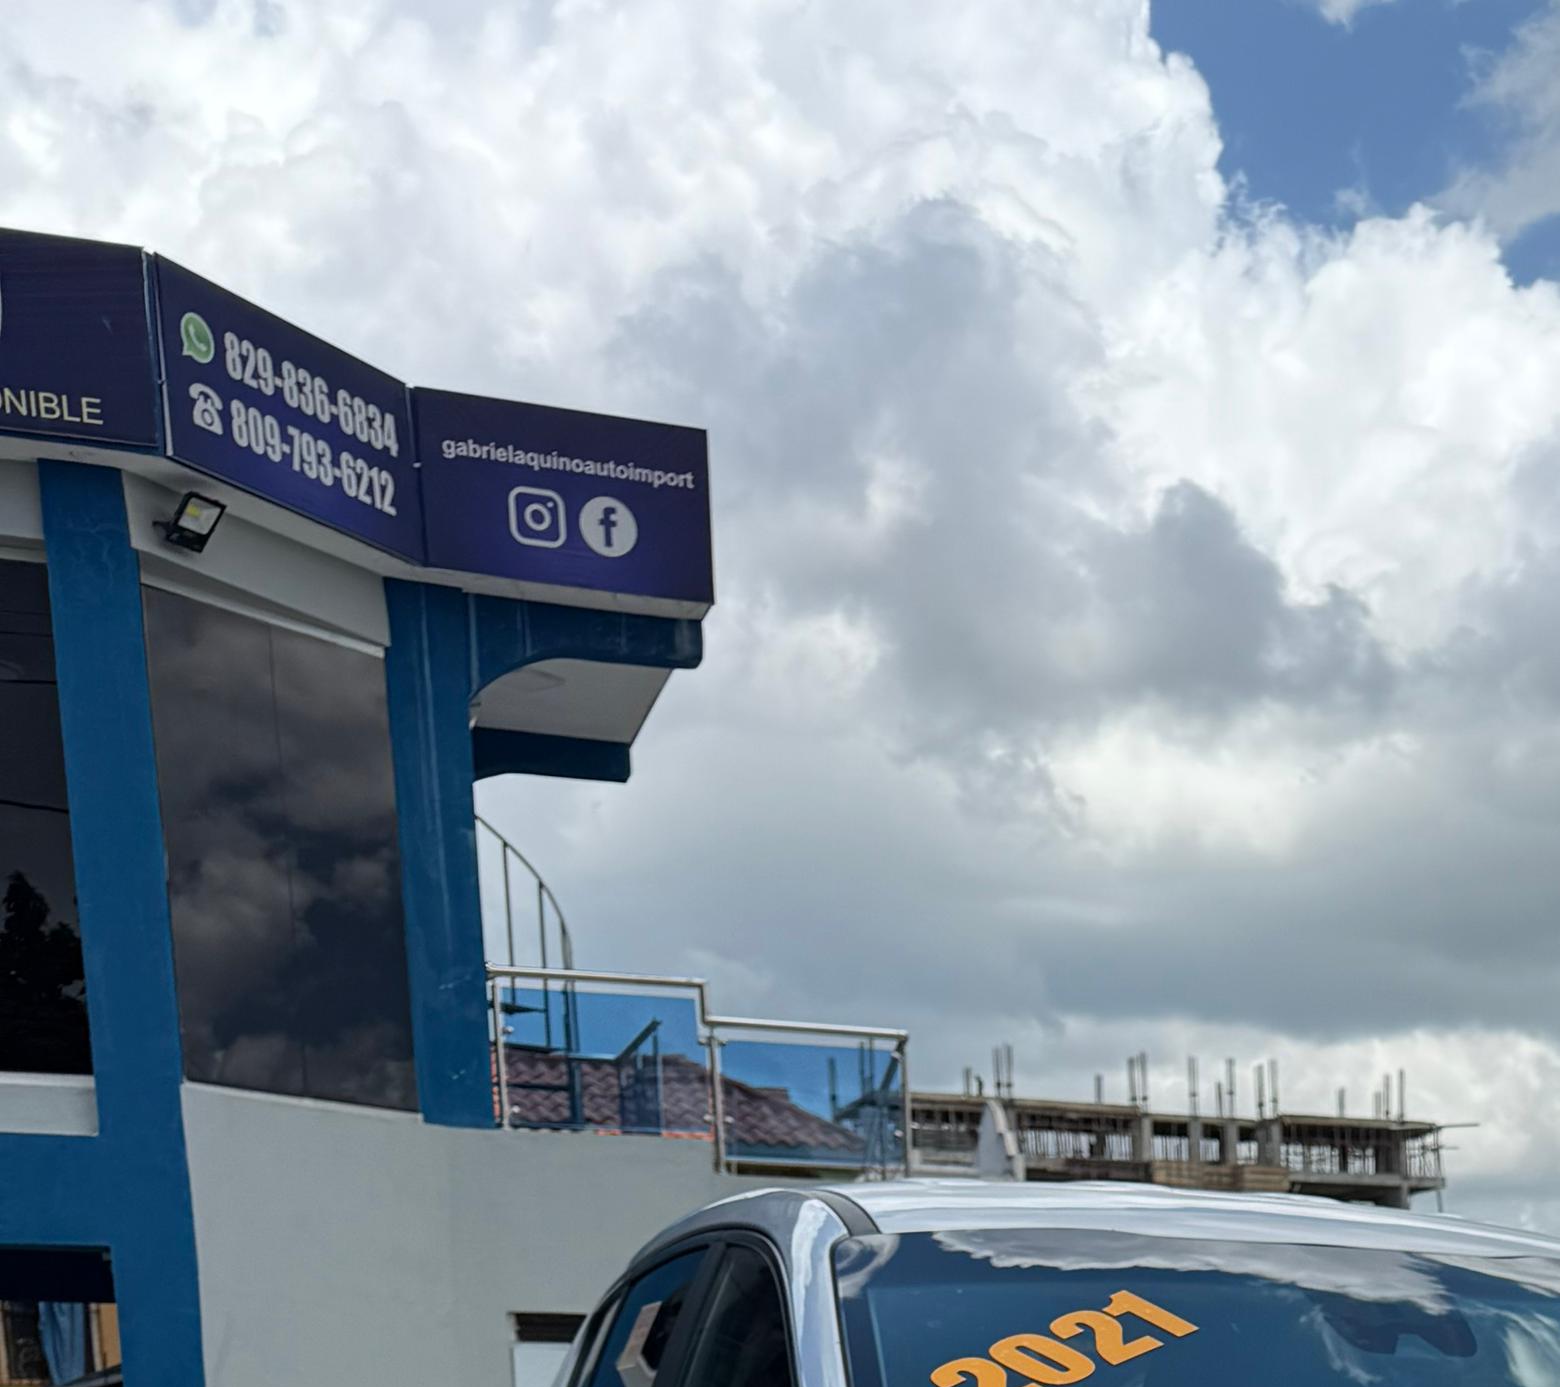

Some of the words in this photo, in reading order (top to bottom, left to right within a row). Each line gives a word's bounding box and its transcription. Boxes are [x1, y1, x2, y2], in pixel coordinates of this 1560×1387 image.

[0, 386, 104, 426] NIBLE
[224, 331, 399, 457] 829-836-6834
[230, 399, 397, 517] 809-793-6212
[441, 438, 695, 489] gabrielaquinoautoimport
